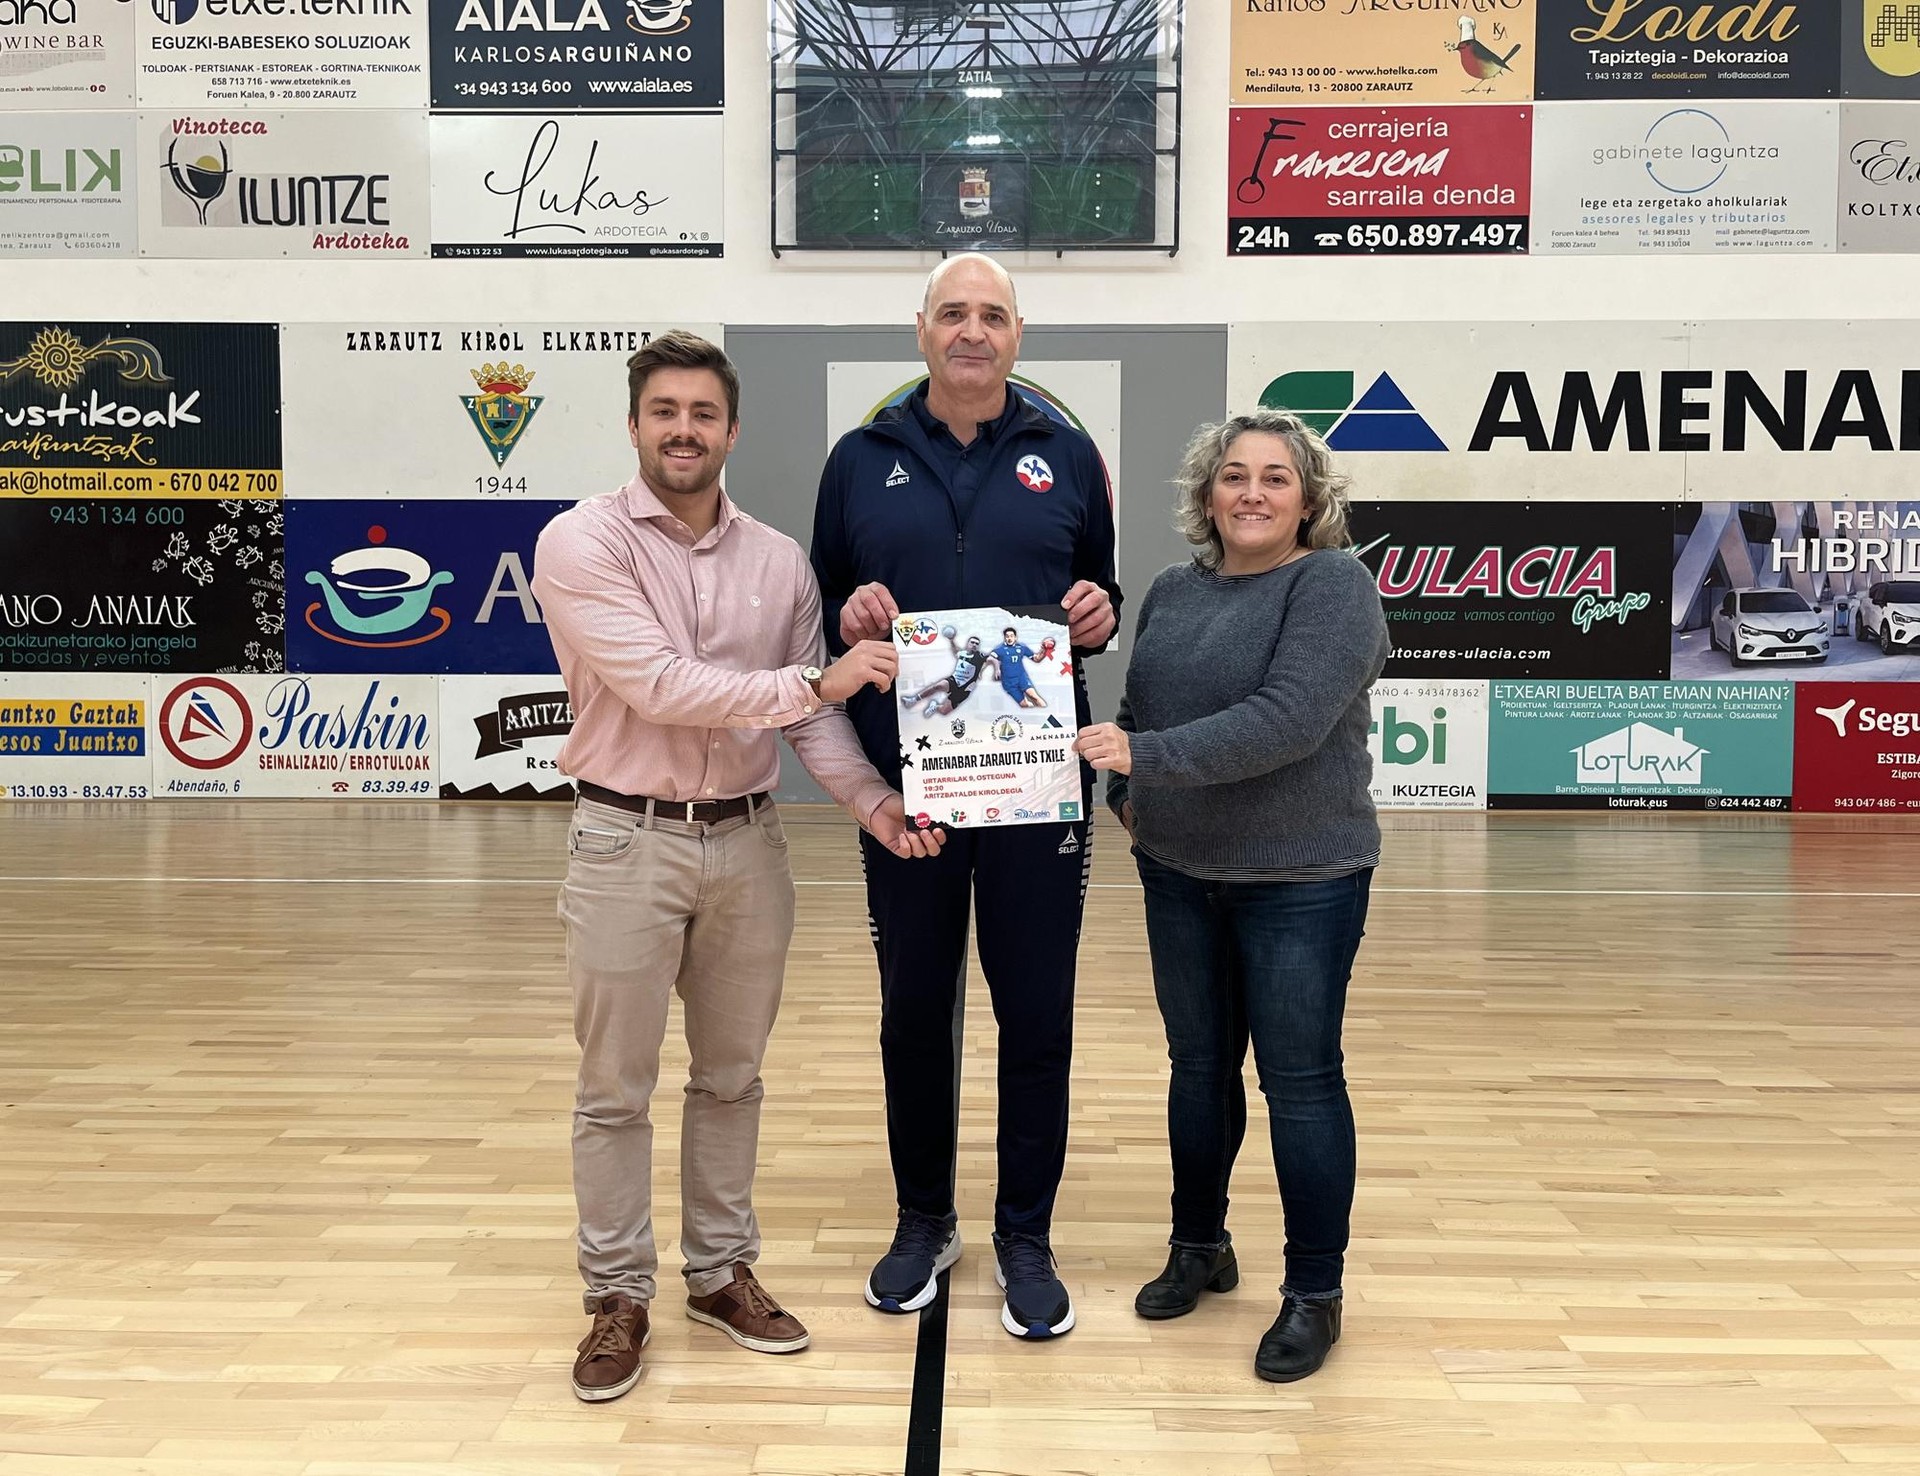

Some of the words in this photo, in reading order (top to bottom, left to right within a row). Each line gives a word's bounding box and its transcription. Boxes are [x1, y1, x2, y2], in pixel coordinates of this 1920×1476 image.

[455, 0, 610, 32] AIALA
[152, 36, 310, 50] EGUZKI-BABESEKO
[315, 36, 411, 49] SOLUZIOAK
[1589, 50, 1676, 66] Tapiztegia
[1693, 50, 1789, 64] Dekorazioa
[142, 64, 188, 73] TOLDOAK
[194, 64, 254, 73] PERTSIANAK
[262, 64, 313, 73] ESTOREAK
[321, 64, 422, 73] GORTINA-TEKNIKOAK
[1245, 68, 1265, 78] Tel.:
[1268, 68, 1288, 77] 943
[1291, 68, 1304, 76] 13
[1306, 67, 1320, 76] 00
[1322, 67, 1336, 76] 00
[1346, 66, 1438, 76] www.hotelka.com
[1718, 72, 1790, 80] info@decoloidi.com
[958, 71, 993, 83] ZATIA
[454, 82, 476, 94] +34
[480, 82, 508, 96] 943
[512, 82, 538, 95] 134
[542, 79, 572, 93] 600
[588, 78, 692, 93] www.aiala.es
[1245, 84, 1304, 94] Mendilauta,
[1308, 84, 1320, 92] 13
[1331, 83, 1363, 92] 20800
[1366, 82, 1414, 92] ZARAUTZ
[207, 90, 238, 98] Foruen
[240, 90, 267, 100] Kalea,
[282, 90, 310, 98] 20.800
[313, 90, 356, 98] ZARAUTZ
[172, 118, 268, 136] Vinoteca
[1328, 117, 1448, 142] cerrajería
[1593, 145, 1682, 164] gabinete
[1691, 145, 1779, 163] laguntza
[484, 120, 669, 239] Lukas
[239, 175, 390, 226] ILUNTZE
[1327, 185, 1424, 206] sarraila
[1433, 184, 1515, 205] denda
[1581, 198, 1607, 210] lege
[1612, 199, 1632, 208] eta
[1638, 198, 1702, 210] zergetako
[1707, 197, 1788, 208] aholkulariak
[1582, 214, 1640, 224] asesores
[1646, 212, 1694, 226] legales
[1712, 212, 1786, 224] tributarios
[594, 226, 668, 236] ARDOTEGIA
[1238, 225, 1290, 248] 24h
[1346, 224, 1523, 248] 650.897.497
[313, 234, 410, 250] Ardoteka
[456, 248, 470, 256] 943
[525, 247, 630, 257] www.lukasardotegia.eus
[347, 332, 442, 351] ZARAUTZ
[543, 332, 652, 351] ELKARTEA
[0, 472, 152, 494] ak@hotmail.com
[170, 473, 202, 492] 670
[208, 473, 240, 492] 042
[246, 473, 277, 492] 700
[475, 476, 527, 494] 1944
[886, 476, 910, 488] SELECT
[50, 506, 88, 524] 943
[100, 506, 136, 524] 134
[145, 506, 184, 524] 600
[1376, 546, 1618, 598] ULACIA
[71, 594, 196, 628] ANAIAK
[1424, 611, 1456, 624] goaz
[1464, 611, 1504, 622] vamos
[1508, 608, 1556, 624] contigo
[1572, 592, 1651, 634] Grupo
[130, 634, 196, 652] jangela
[12, 651, 72, 664] bodas
[79, 652, 90, 668] y
[96, 652, 170, 666] eventos
[1418, 688, 1480, 697] 943478362
[1495, 685, 1560, 700] ETXEARI
[1566, 686, 1623, 700] BUELTA
[1629, 686, 1659, 700] BAT
[1664, 686, 1712, 700] EMAN
[1717, 686, 1790, 701] NAHIAN?
[1, 704, 56, 724] antxo
[70, 702, 138, 724] Gaztak
[259, 676, 430, 750] Paskin
[54, 730, 138, 752] Juantxo
[1030, 733, 1076, 741] AMENABAR
[922, 755, 978, 771] AMENABAR
[980, 752, 1022, 767] ZARAUTZ
[1024, 750, 1038, 764] VS
[1040, 749, 1066, 762] TXILE
[976, 772, 1017, 781] OSTEGUNA
[10, 785, 68, 798] 13.10.93
[82, 786, 147, 798] 83.47.53
[168, 779, 228, 793] Abendaño,
[234, 780, 240, 792] 6
[362, 780, 430, 794] 83.39.49
[978, 788, 1024, 796] KIROLDEGIA
[1392, 785, 1476, 798] IKUZTEGIA
[1556, 785, 1578, 794] Barne
[1580, 785, 1614, 794] Diseinua
[1621, 786, 1671, 794] Berrikuntzak
[1677, 786, 1722, 795] Dekorazioa
[1608, 796, 1668, 808] loturak.eus
[1720, 798, 1738, 808] 624
[1740, 798, 1761, 808] 442
[1763, 798, 1782, 808] 487
[1835, 798, 1854, 807] 943
[1856, 798, 1875, 807] 047
[1877, 798, 1896, 807] 486
[1058, 844, 1079, 854] SELECT
